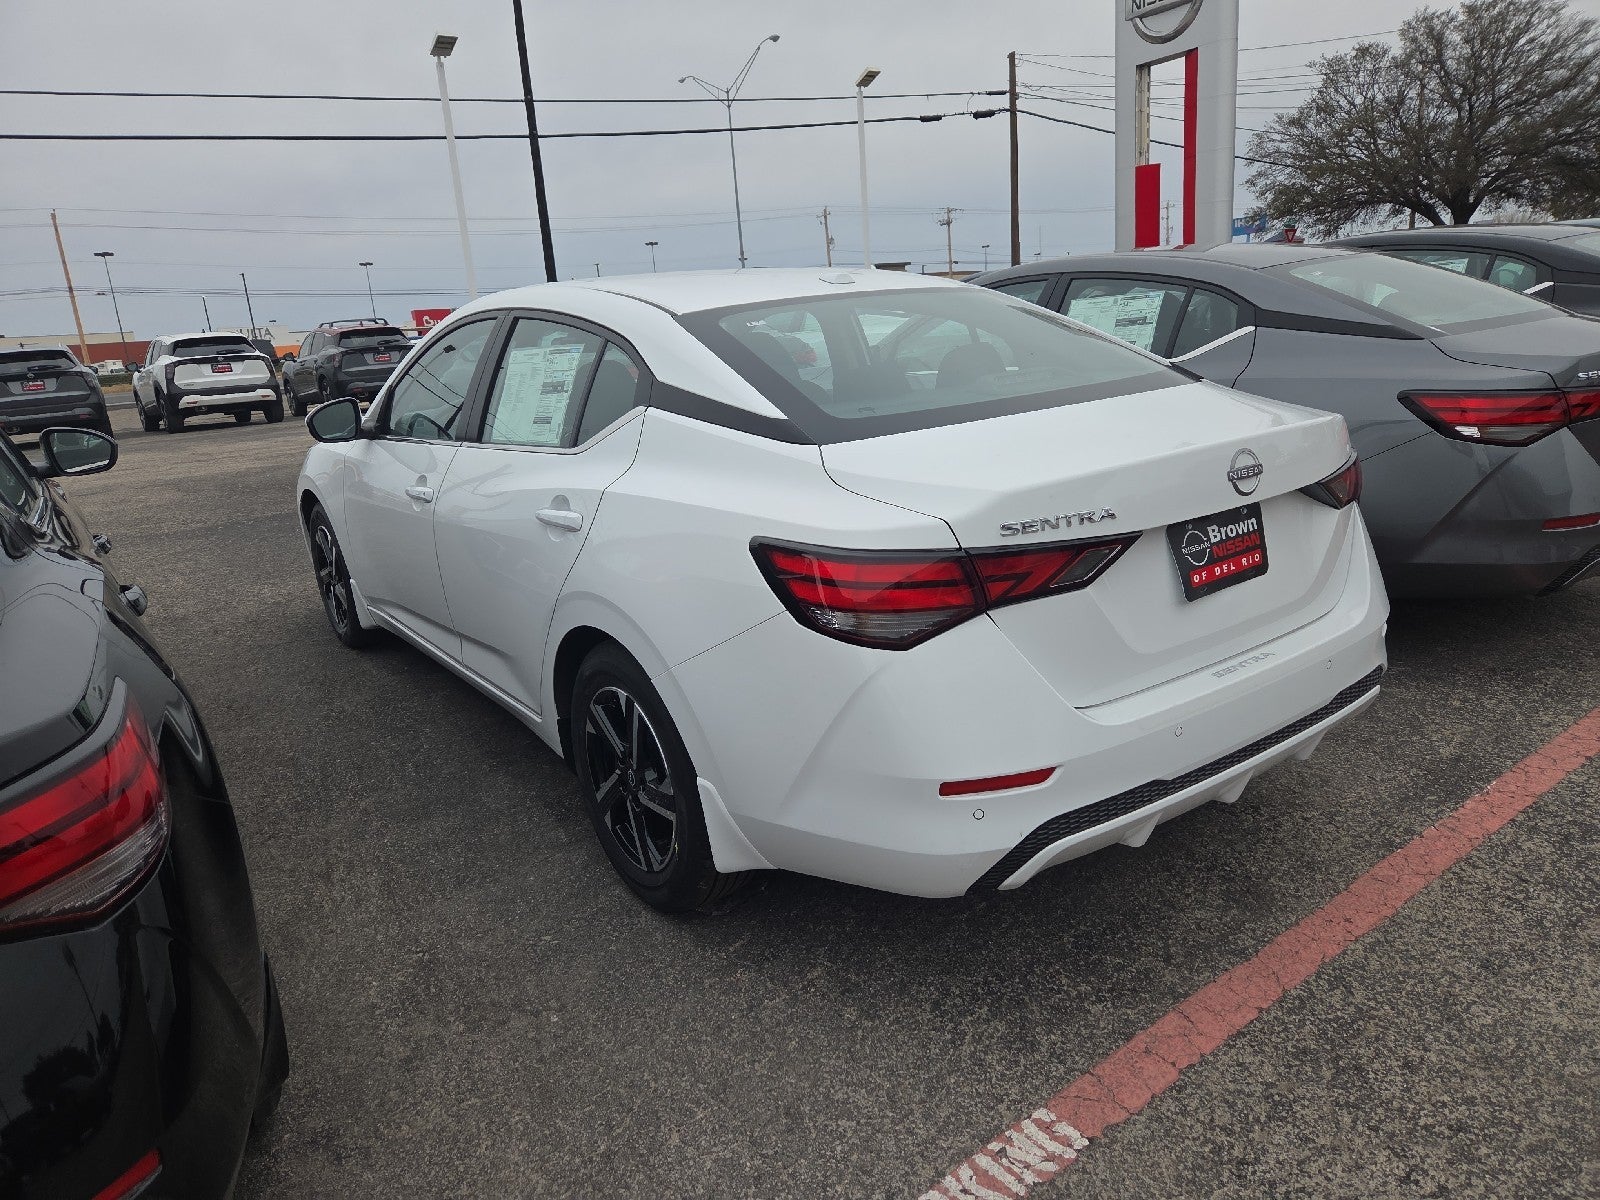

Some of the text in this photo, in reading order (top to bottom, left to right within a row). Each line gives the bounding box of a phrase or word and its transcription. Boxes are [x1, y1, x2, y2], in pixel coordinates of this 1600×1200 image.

[1577, 370, 1600, 381] SE
[999, 507, 1117, 538] SENTRA
[1207, 517, 1258, 543] Brown
[1181, 541, 1211, 555] NISSAN
[1212, 531, 1260, 558] NISSAN
[1193, 552, 1260, 583] OF DEL RIO
